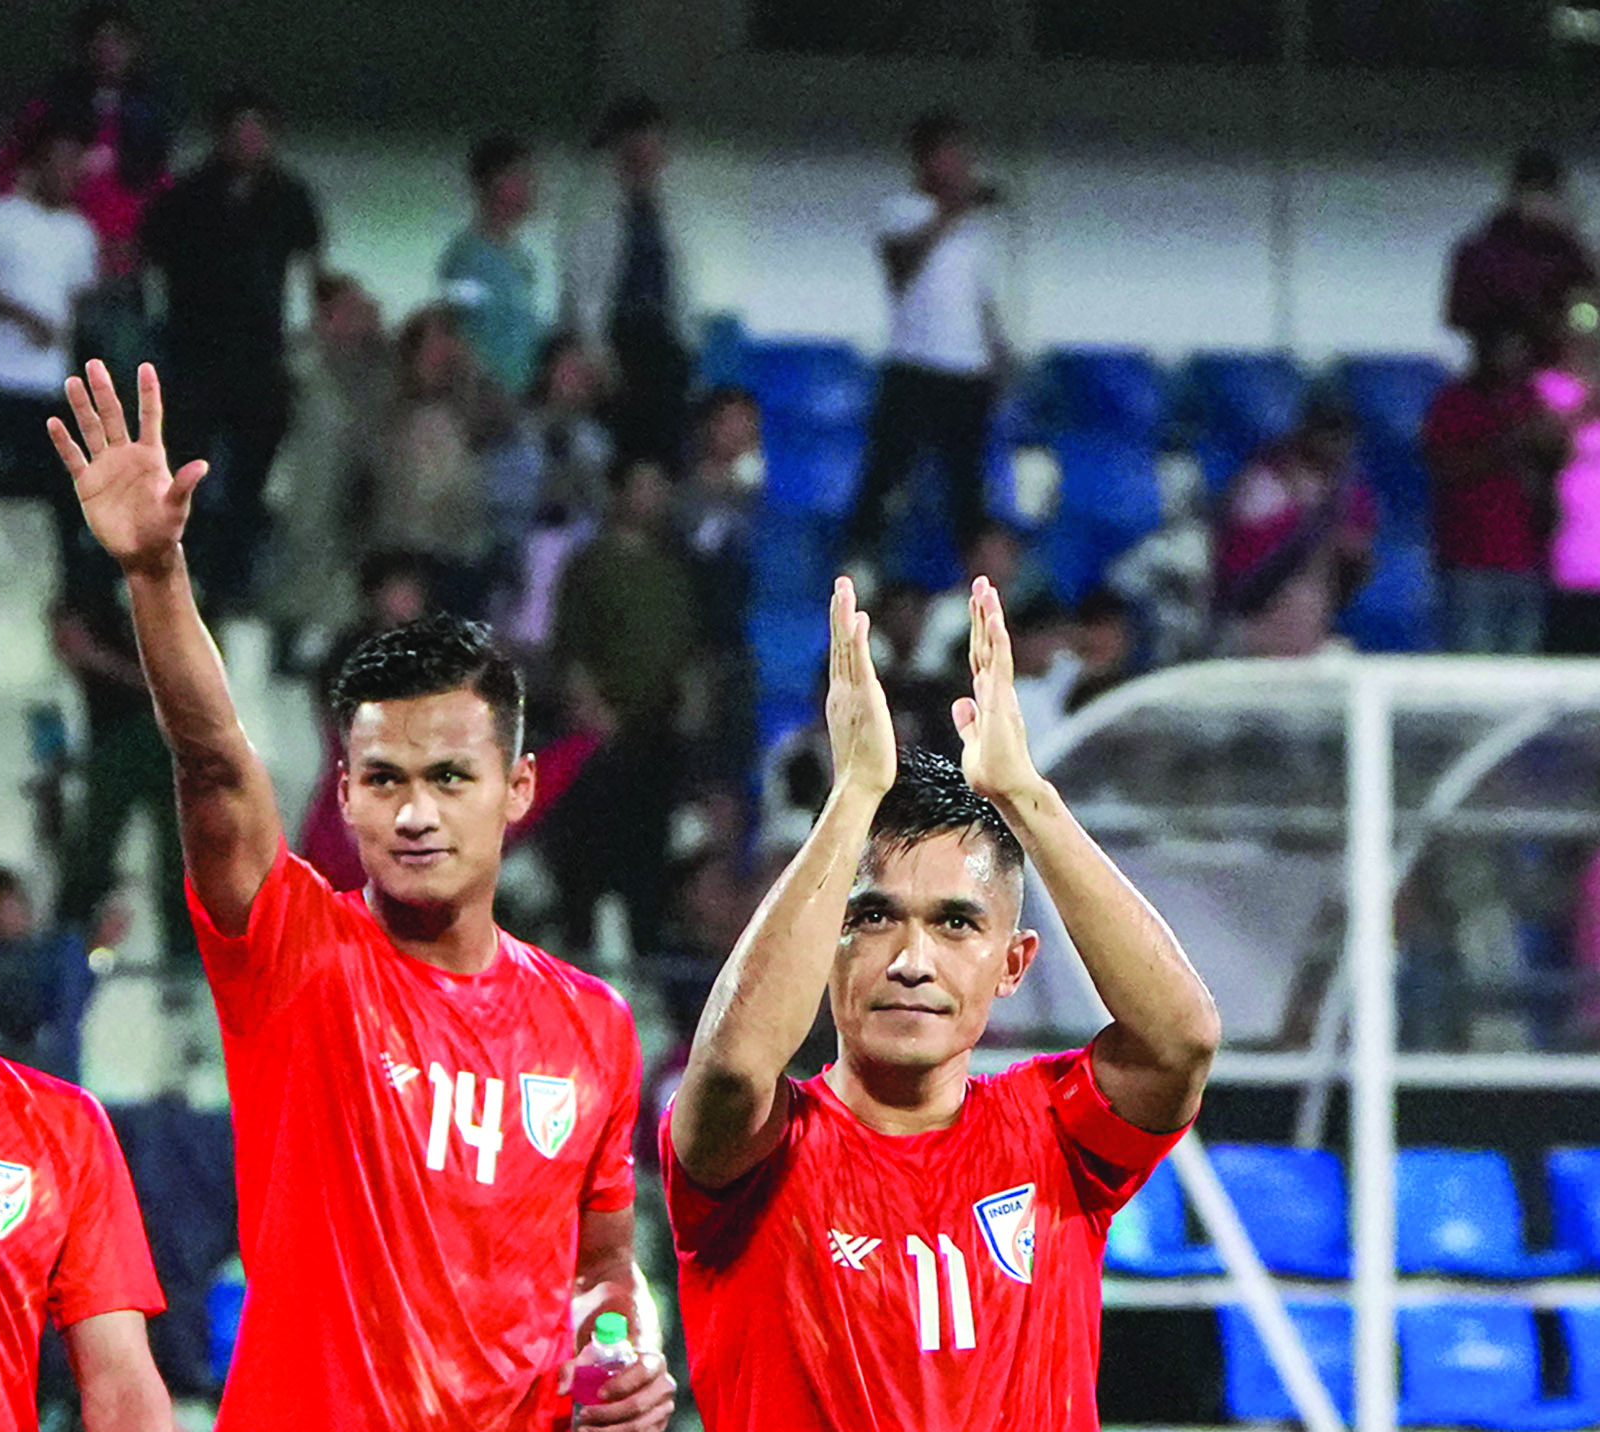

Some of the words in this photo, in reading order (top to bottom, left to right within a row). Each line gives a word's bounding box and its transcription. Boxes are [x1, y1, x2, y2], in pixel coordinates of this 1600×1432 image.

[426, 1061, 504, 1184] 14
[988, 1200, 1024, 1219] INDIA
[906, 1233, 976, 1350] 11
